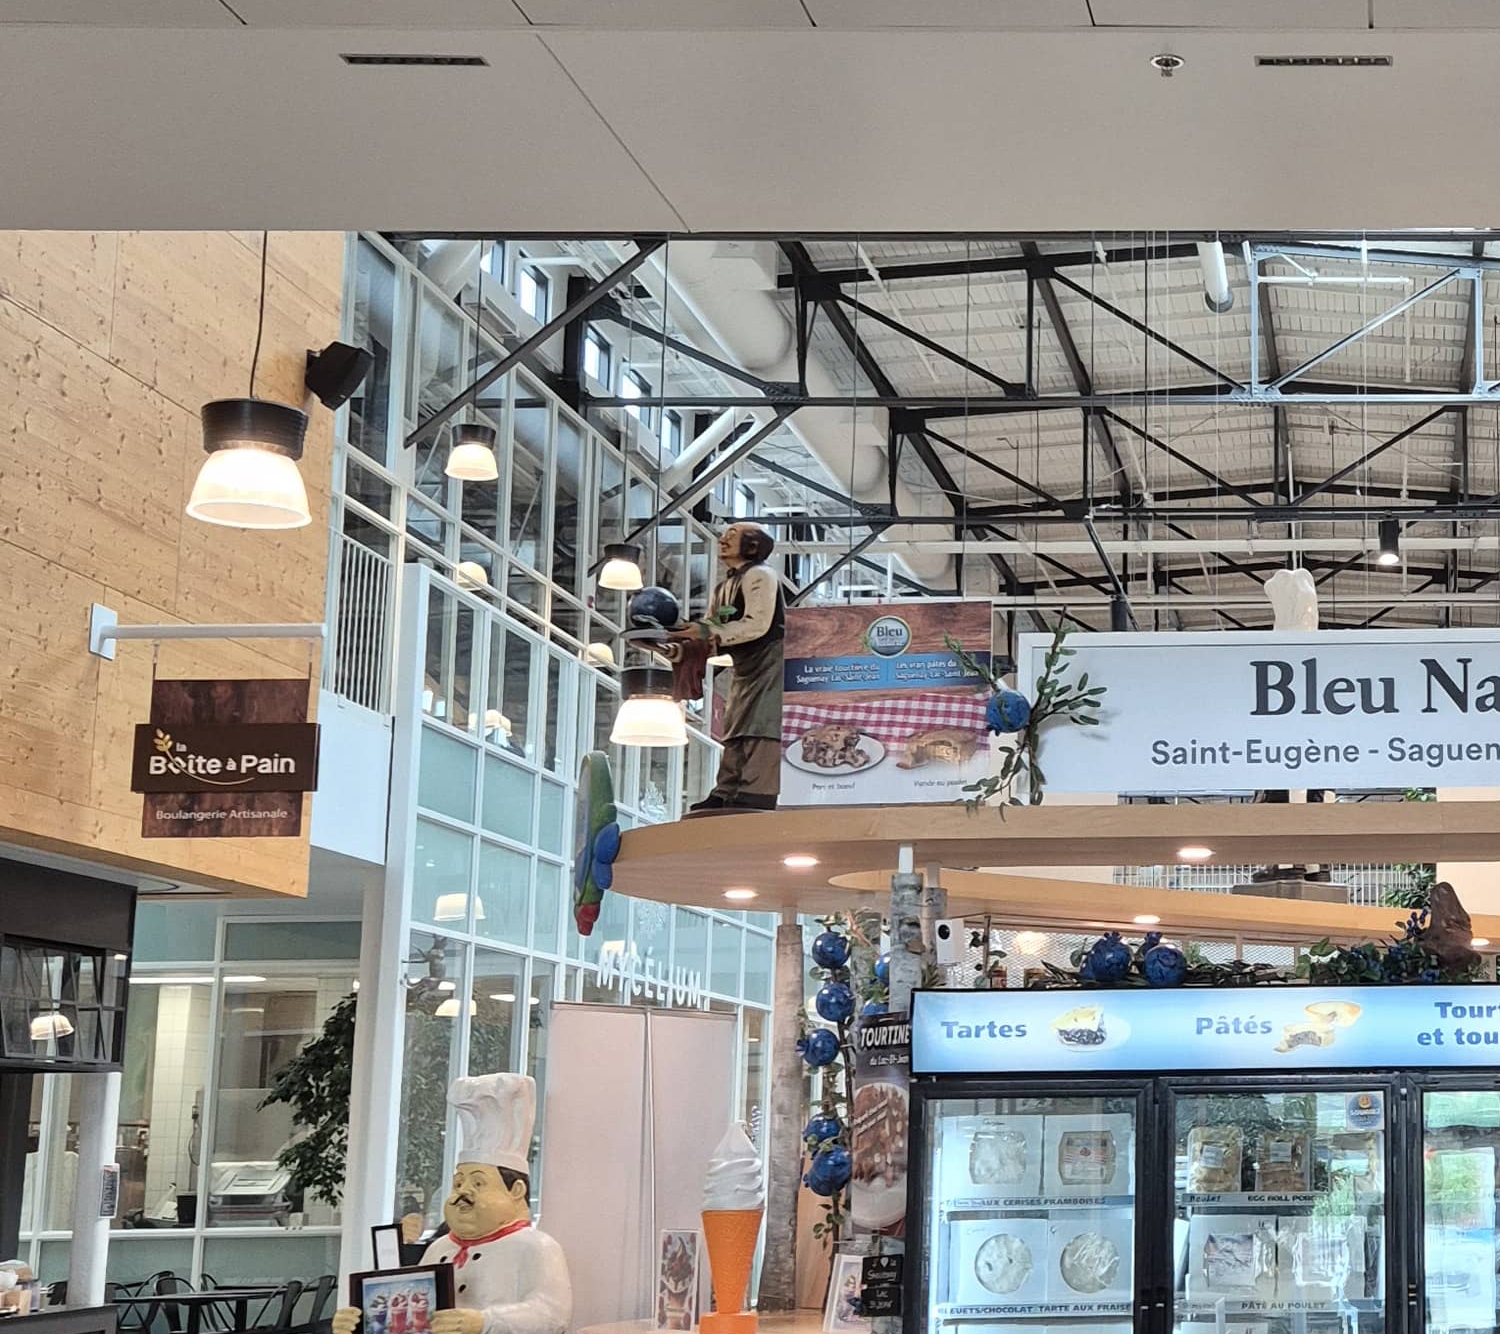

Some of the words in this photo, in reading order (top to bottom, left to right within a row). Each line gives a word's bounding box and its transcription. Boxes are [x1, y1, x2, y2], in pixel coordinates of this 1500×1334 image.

[876, 626, 903, 637] Bleu
[1250, 659, 1396, 717] Bleu
[176, 742, 187, 753] la
[1151, 737, 1360, 771] Saint-Eugène
[226, 758, 236, 771] à
[240, 753, 296, 774] Pain
[156, 809, 226, 822] Boulangerie
[229, 808, 288, 819] Artisanale
[596, 947, 701, 1009] MYCÉLIUM
[941, 1020, 1027, 1039] Tartes
[1195, 1015, 1273, 1036] Pâtés
[860, 1024, 910, 1047] TOURTINE
[1417, 1028, 1444, 1045] et
[1003, 1198, 1042, 1206] CERISES
[1039, 1305, 1069, 1313] TARTE
[1073, 1304, 1096, 1312] AUX
[1287, 1301, 1325, 1309] POULET
